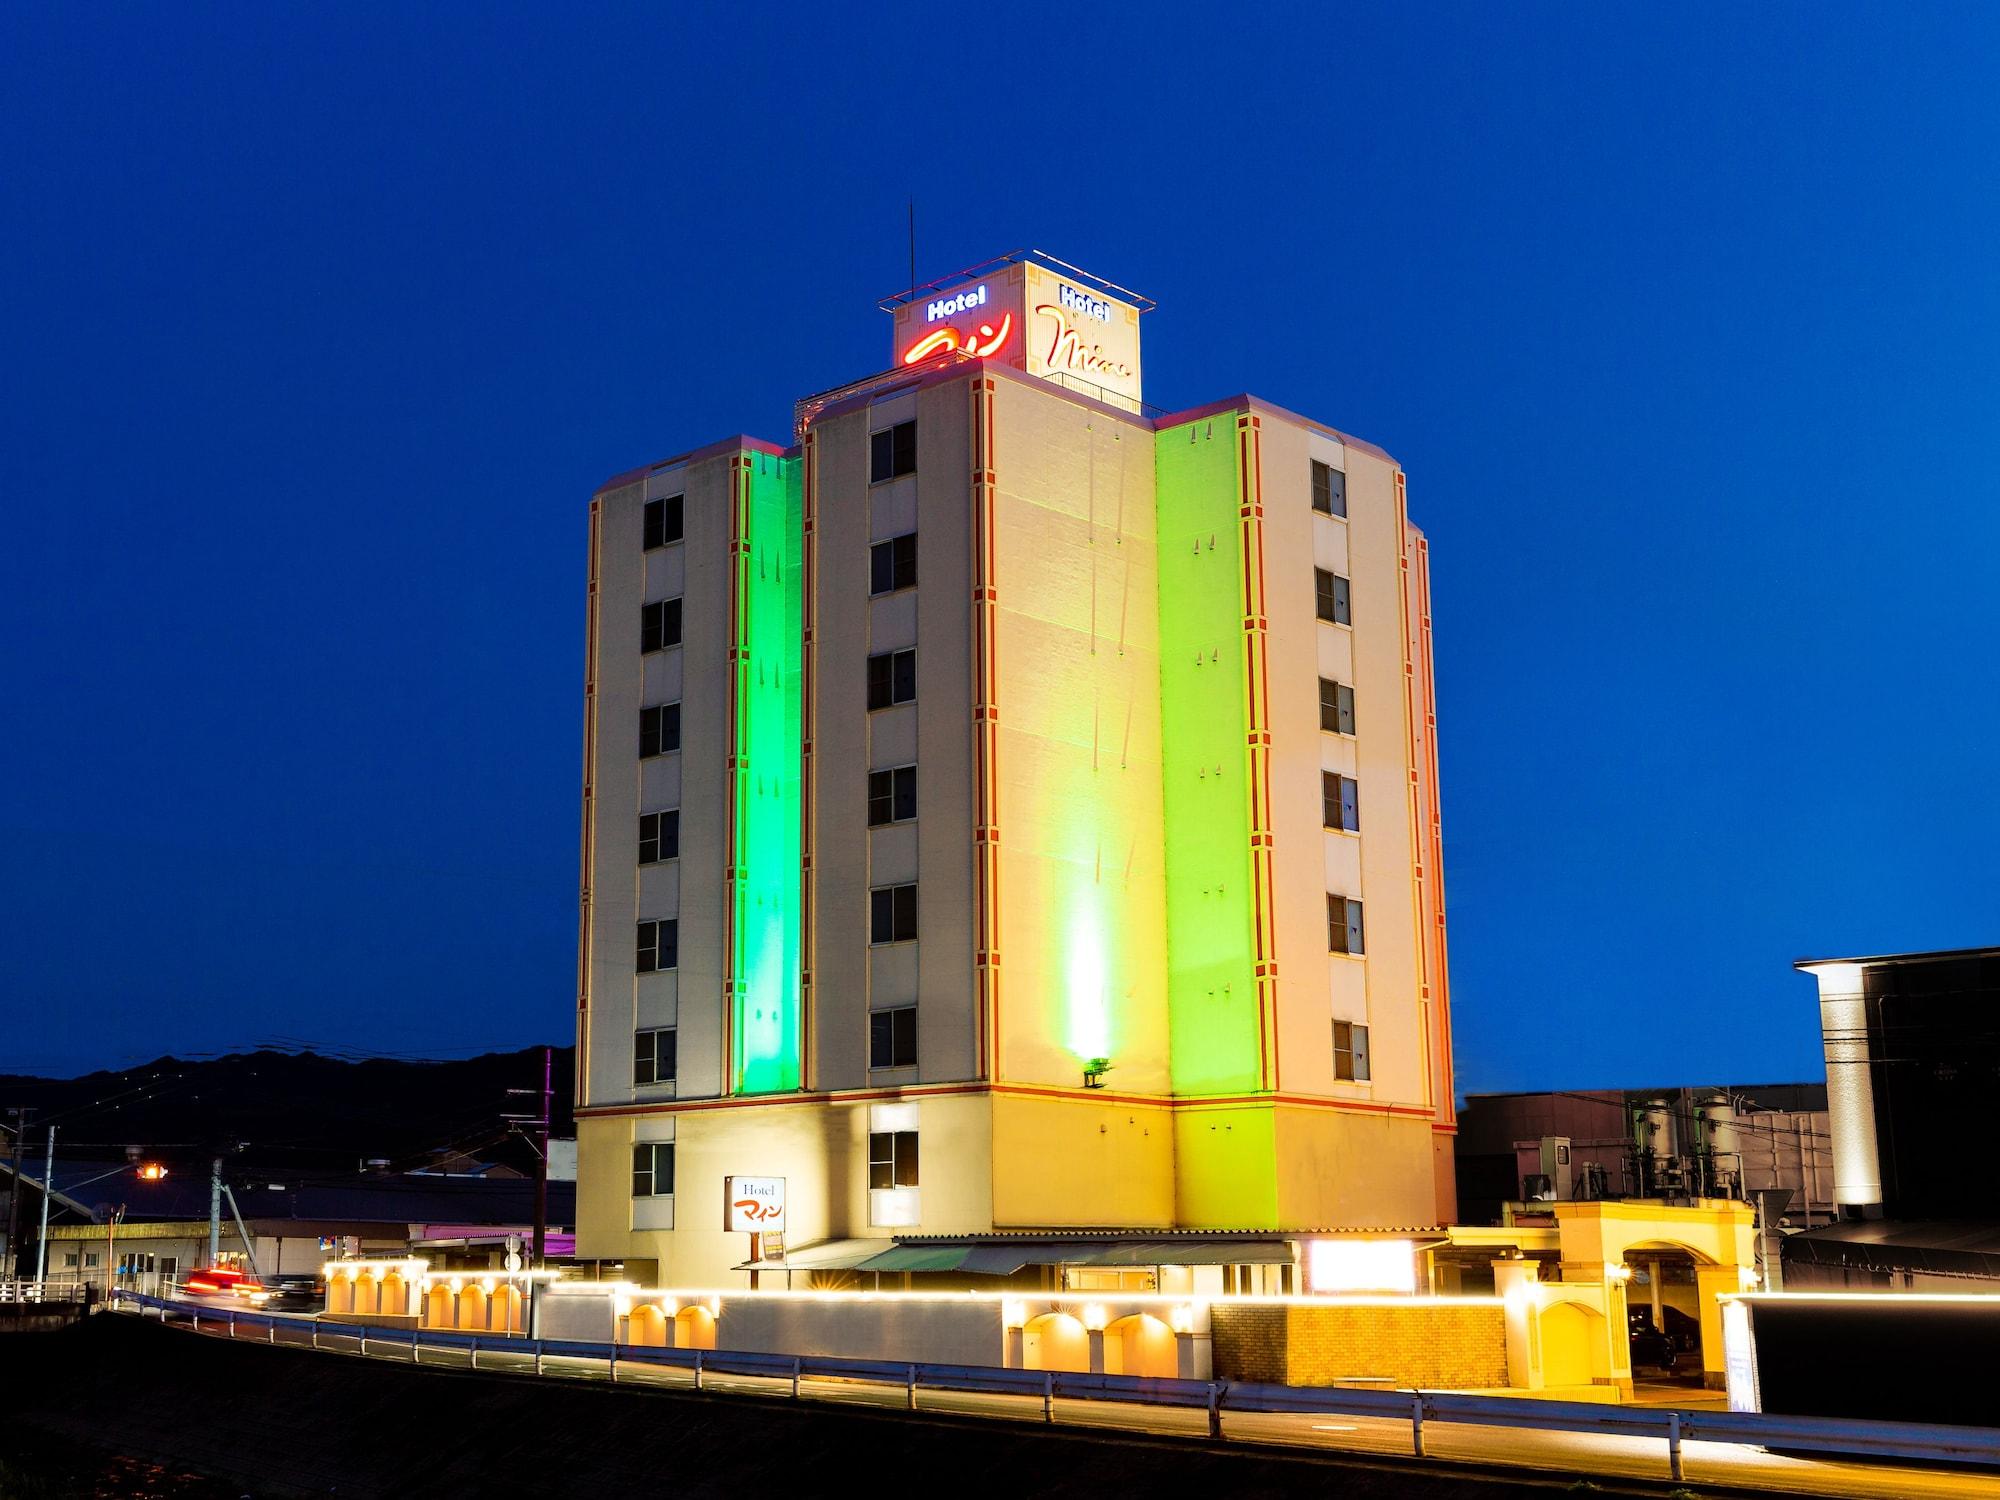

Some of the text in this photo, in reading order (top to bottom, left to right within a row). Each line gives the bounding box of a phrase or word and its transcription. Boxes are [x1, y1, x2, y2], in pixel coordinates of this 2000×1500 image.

[927, 284, 986, 322] Hotel
[1059, 283, 1111, 324] Hotel
[744, 1184, 775, 1196] Hotel
[733, 1199, 783, 1222] マイン
